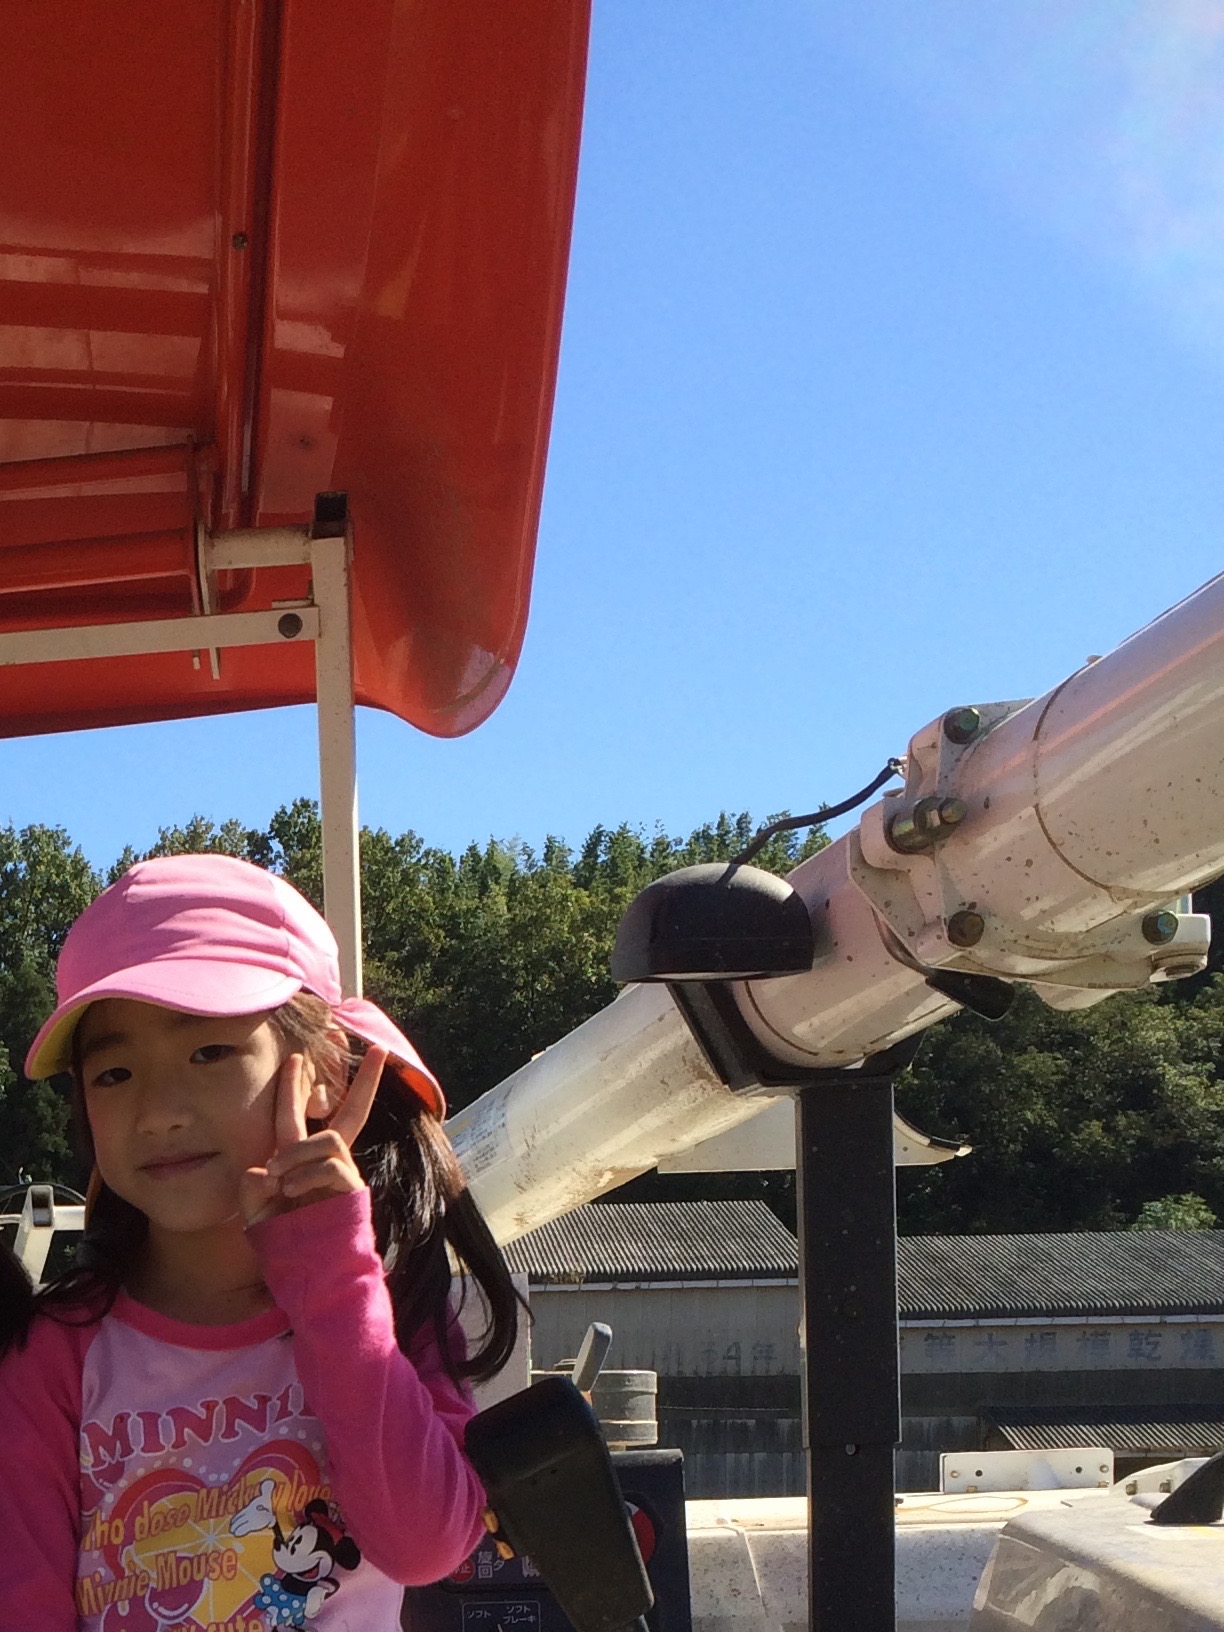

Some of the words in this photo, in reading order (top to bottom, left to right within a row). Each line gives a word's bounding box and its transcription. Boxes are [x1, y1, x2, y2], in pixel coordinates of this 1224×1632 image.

[82, 1383, 316, 1470] MINNI
[155, 1547, 238, 1593] Mouse
[467, 1610, 492, 1619] ソフト
[506, 1605, 531, 1614] ソフト
